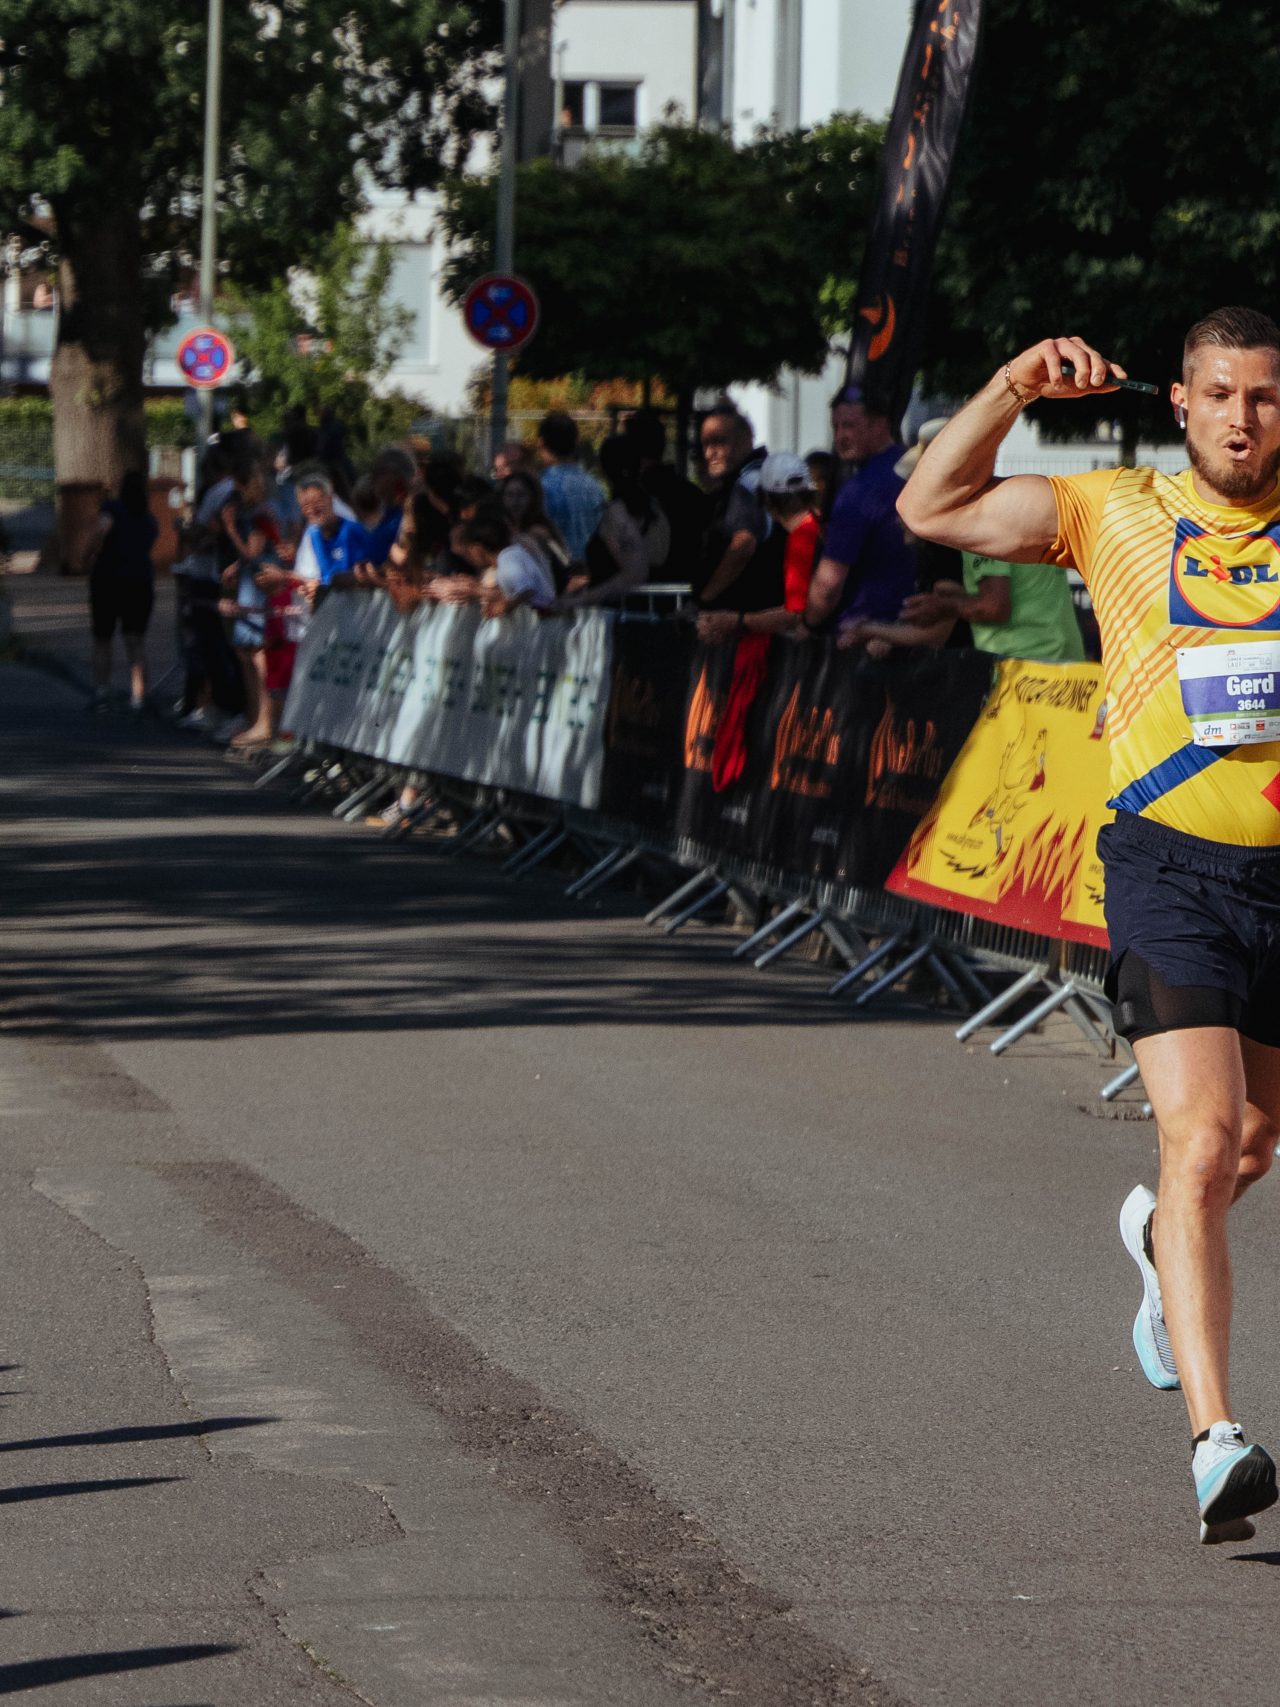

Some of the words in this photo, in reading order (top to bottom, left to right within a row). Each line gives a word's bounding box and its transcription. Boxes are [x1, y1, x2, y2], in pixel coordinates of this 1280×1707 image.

[1183, 554, 1279, 586] LIDL
[1226, 673, 1275, 697] Gerd
[1237, 698, 1266, 712] 3644
[1204, 724, 1222, 736] dm
